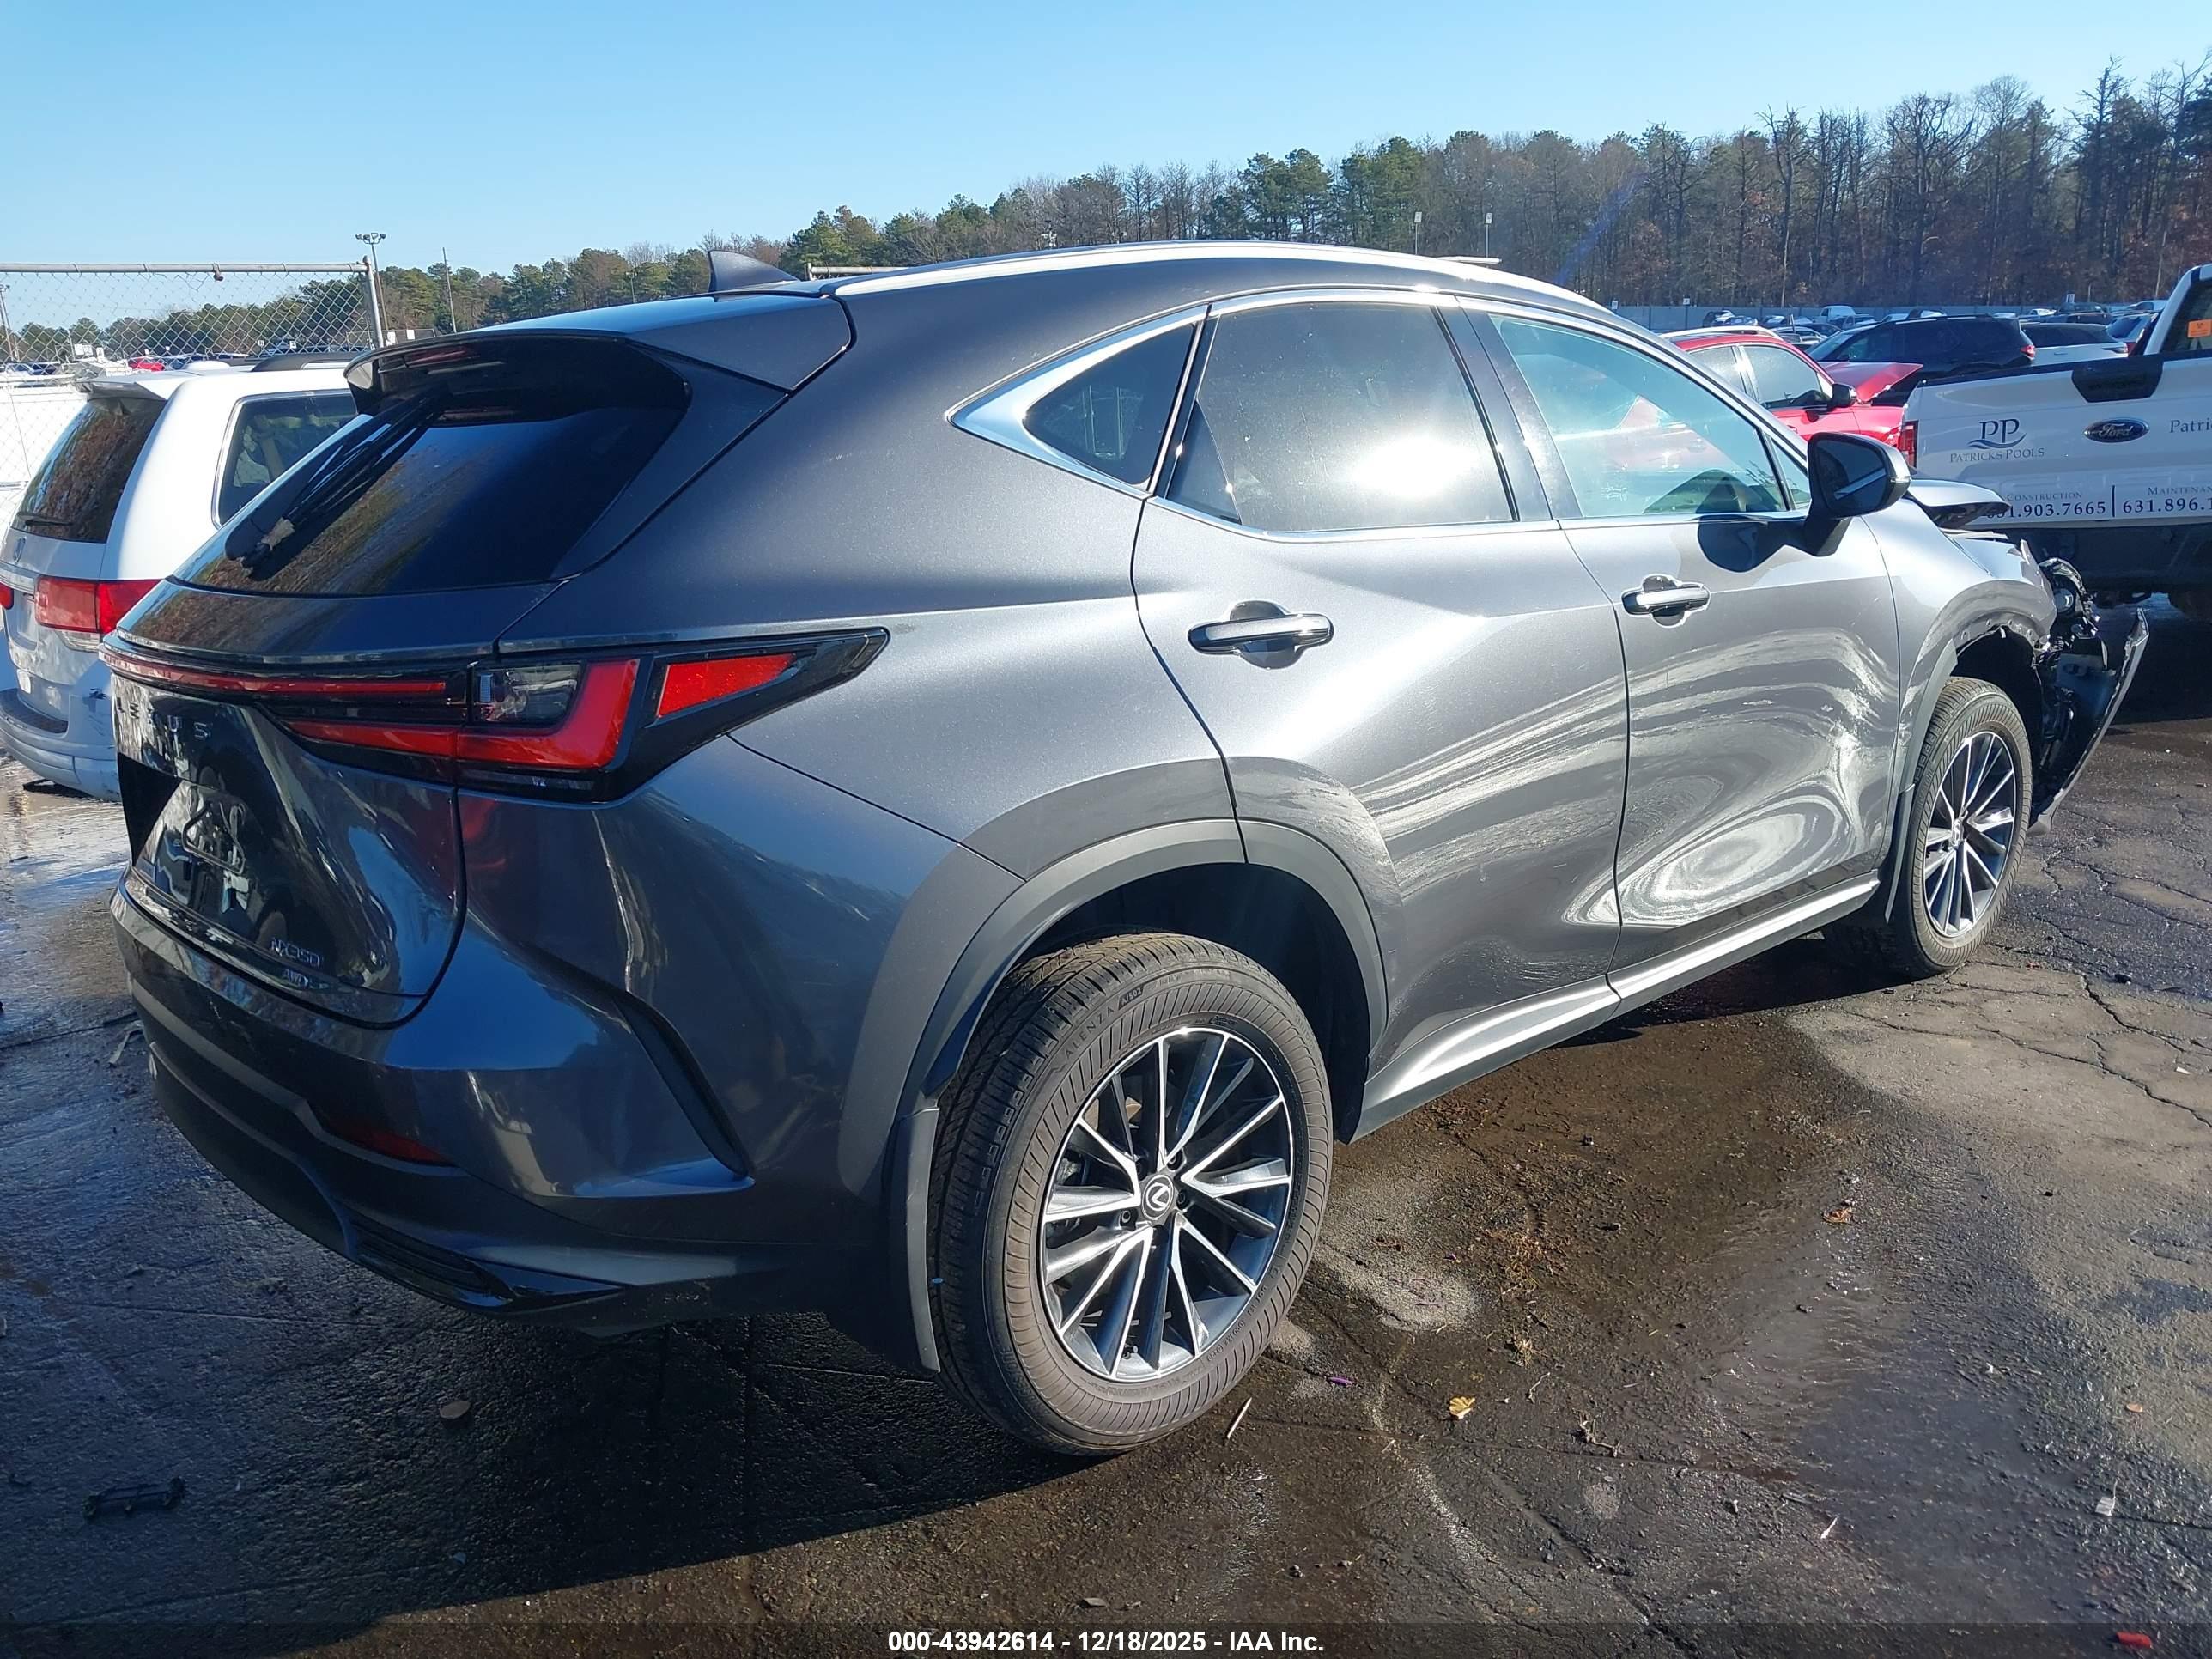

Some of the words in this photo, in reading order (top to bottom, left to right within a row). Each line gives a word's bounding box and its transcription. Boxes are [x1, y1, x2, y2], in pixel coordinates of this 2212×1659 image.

[1979, 418, 2020, 443] PP
[2170, 417, 2212, 433] Patri
[1950, 452, 2003, 463] PATRICKS
[2006, 447, 2045, 459] POOLS
[2007, 492, 2083, 502] CONSTRUCTION
[1987, 501, 2106, 518] 1.903.7665
[1065, 1007, 1115, 1059] ALENZA
